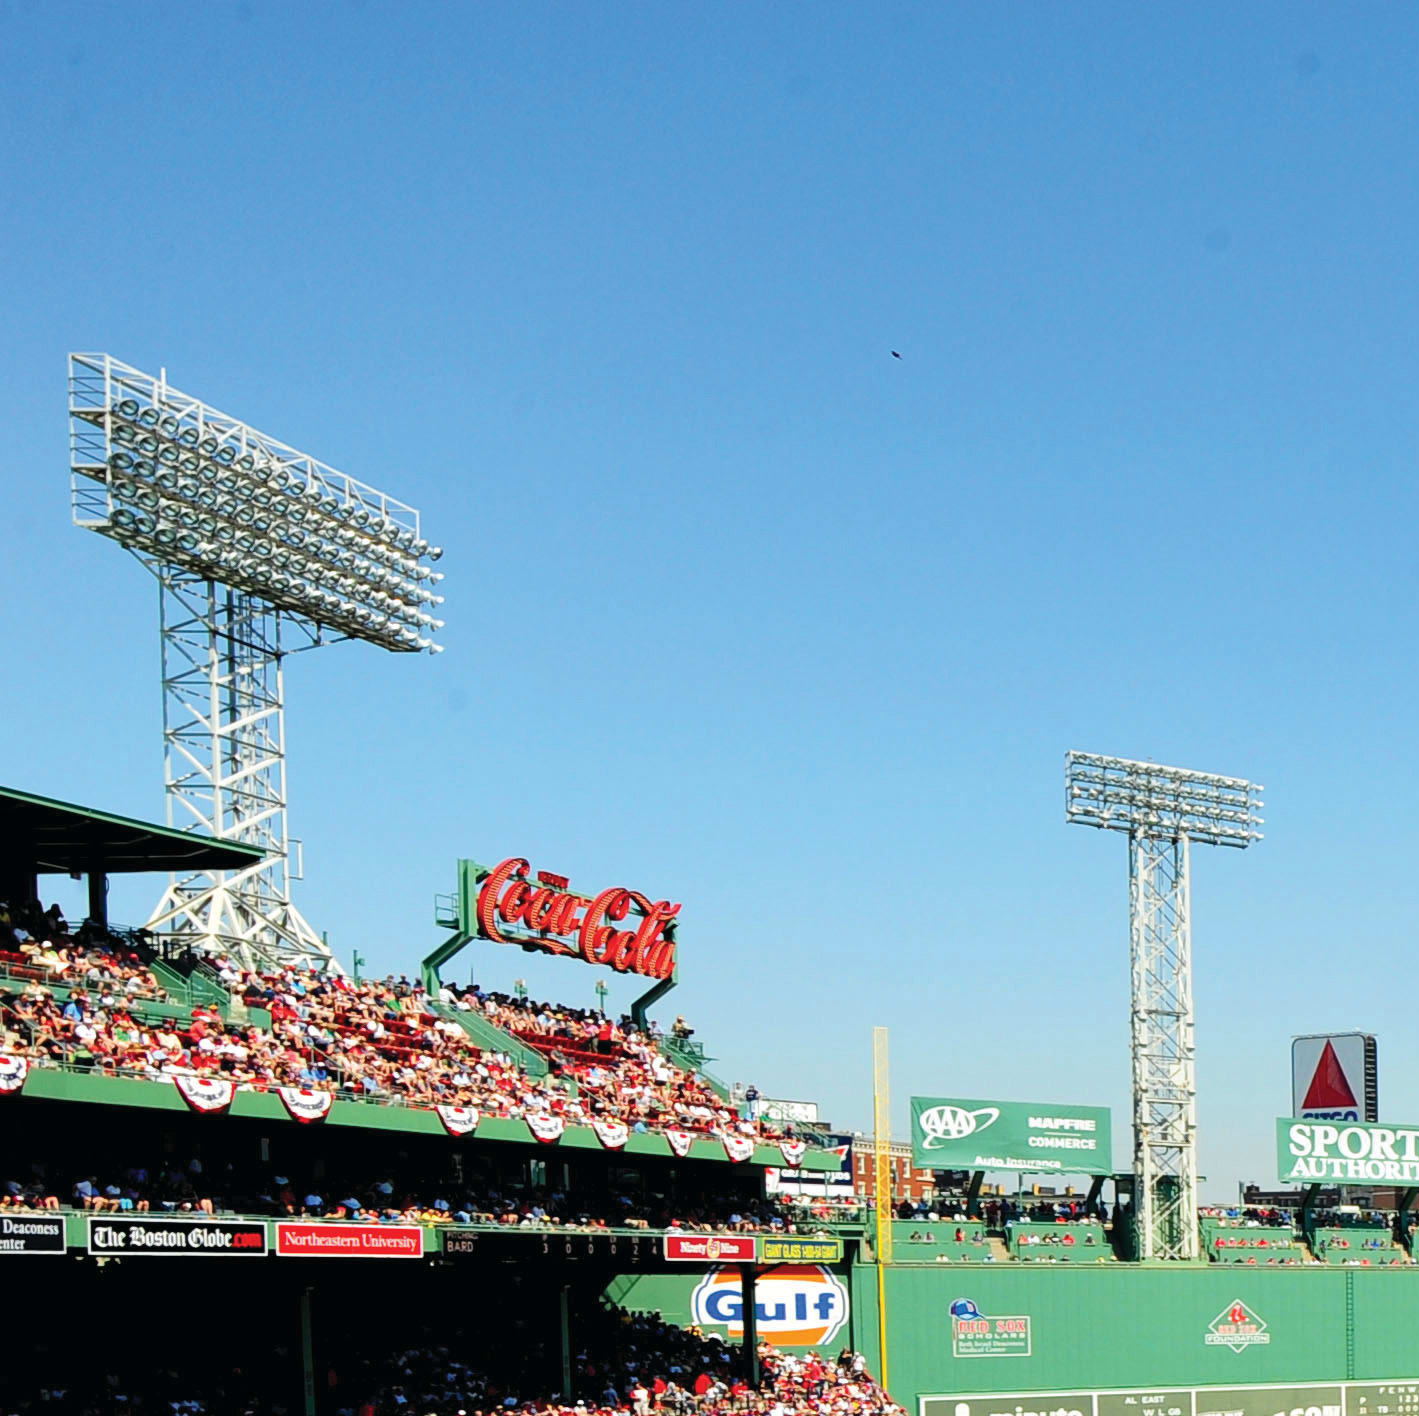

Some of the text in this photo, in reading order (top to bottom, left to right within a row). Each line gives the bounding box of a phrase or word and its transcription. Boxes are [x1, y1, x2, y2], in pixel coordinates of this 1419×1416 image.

[926, 1107, 969, 1135] AAA
[1028, 1117, 1096, 1131] MAPFRE
[1028, 1136, 1096, 1150] COMMERCE
[2, 1219, 60, 1236] Deaconess
[94, 1226, 263, 1249] The Boston Globe.com
[284, 1231, 418, 1252] Northeastern University
[447, 1241, 474, 1253] BARD
[680, 1241, 740, 1255] Ninety Nine
[705, 1289, 836, 1322] Gulf
[958, 1320, 1026, 1333] RED SOX
[1125, 1396, 1165, 1404] AL EAST
